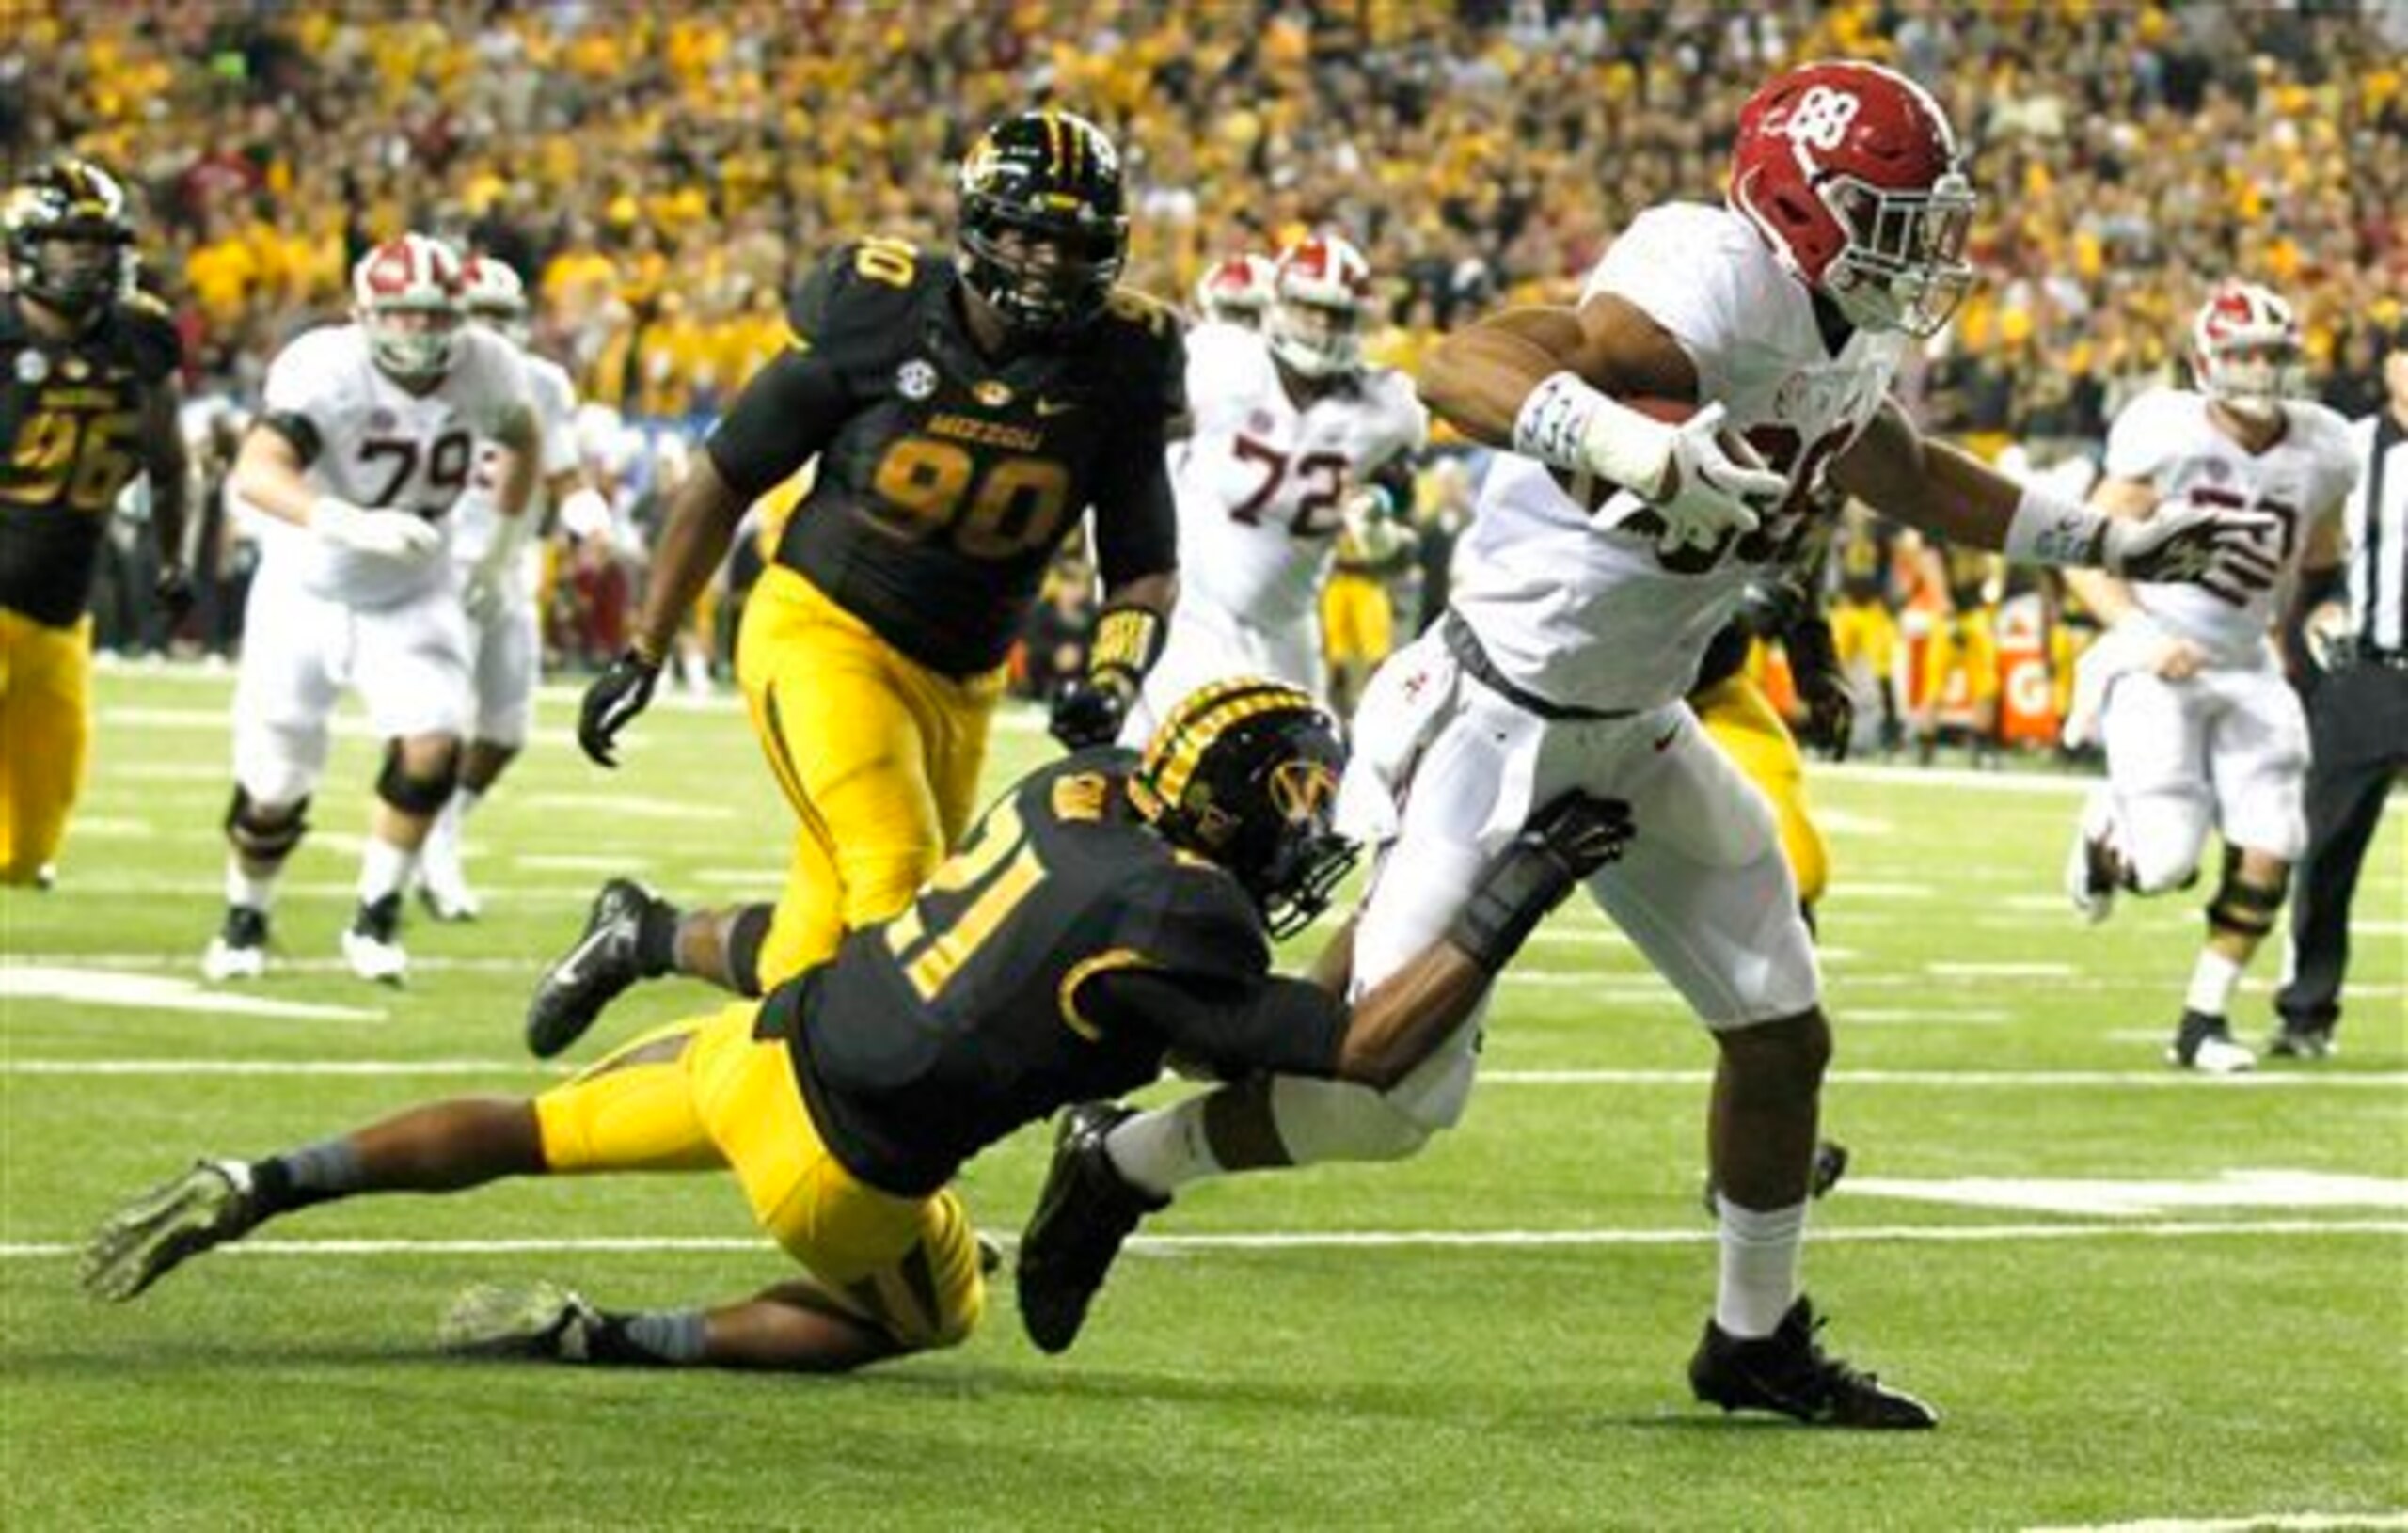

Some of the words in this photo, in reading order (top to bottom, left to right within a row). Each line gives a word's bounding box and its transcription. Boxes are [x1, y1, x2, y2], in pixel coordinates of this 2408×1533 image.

[1786, 85, 1860, 150] 88
[1, 412, 143, 506] 96
[356, 427, 473, 522] 79
[874, 436, 1072, 560] 90
[1228, 432, 1349, 538] 72
[2006, 660, 2049, 717] G
[884, 788, 1050, 1003] 21
